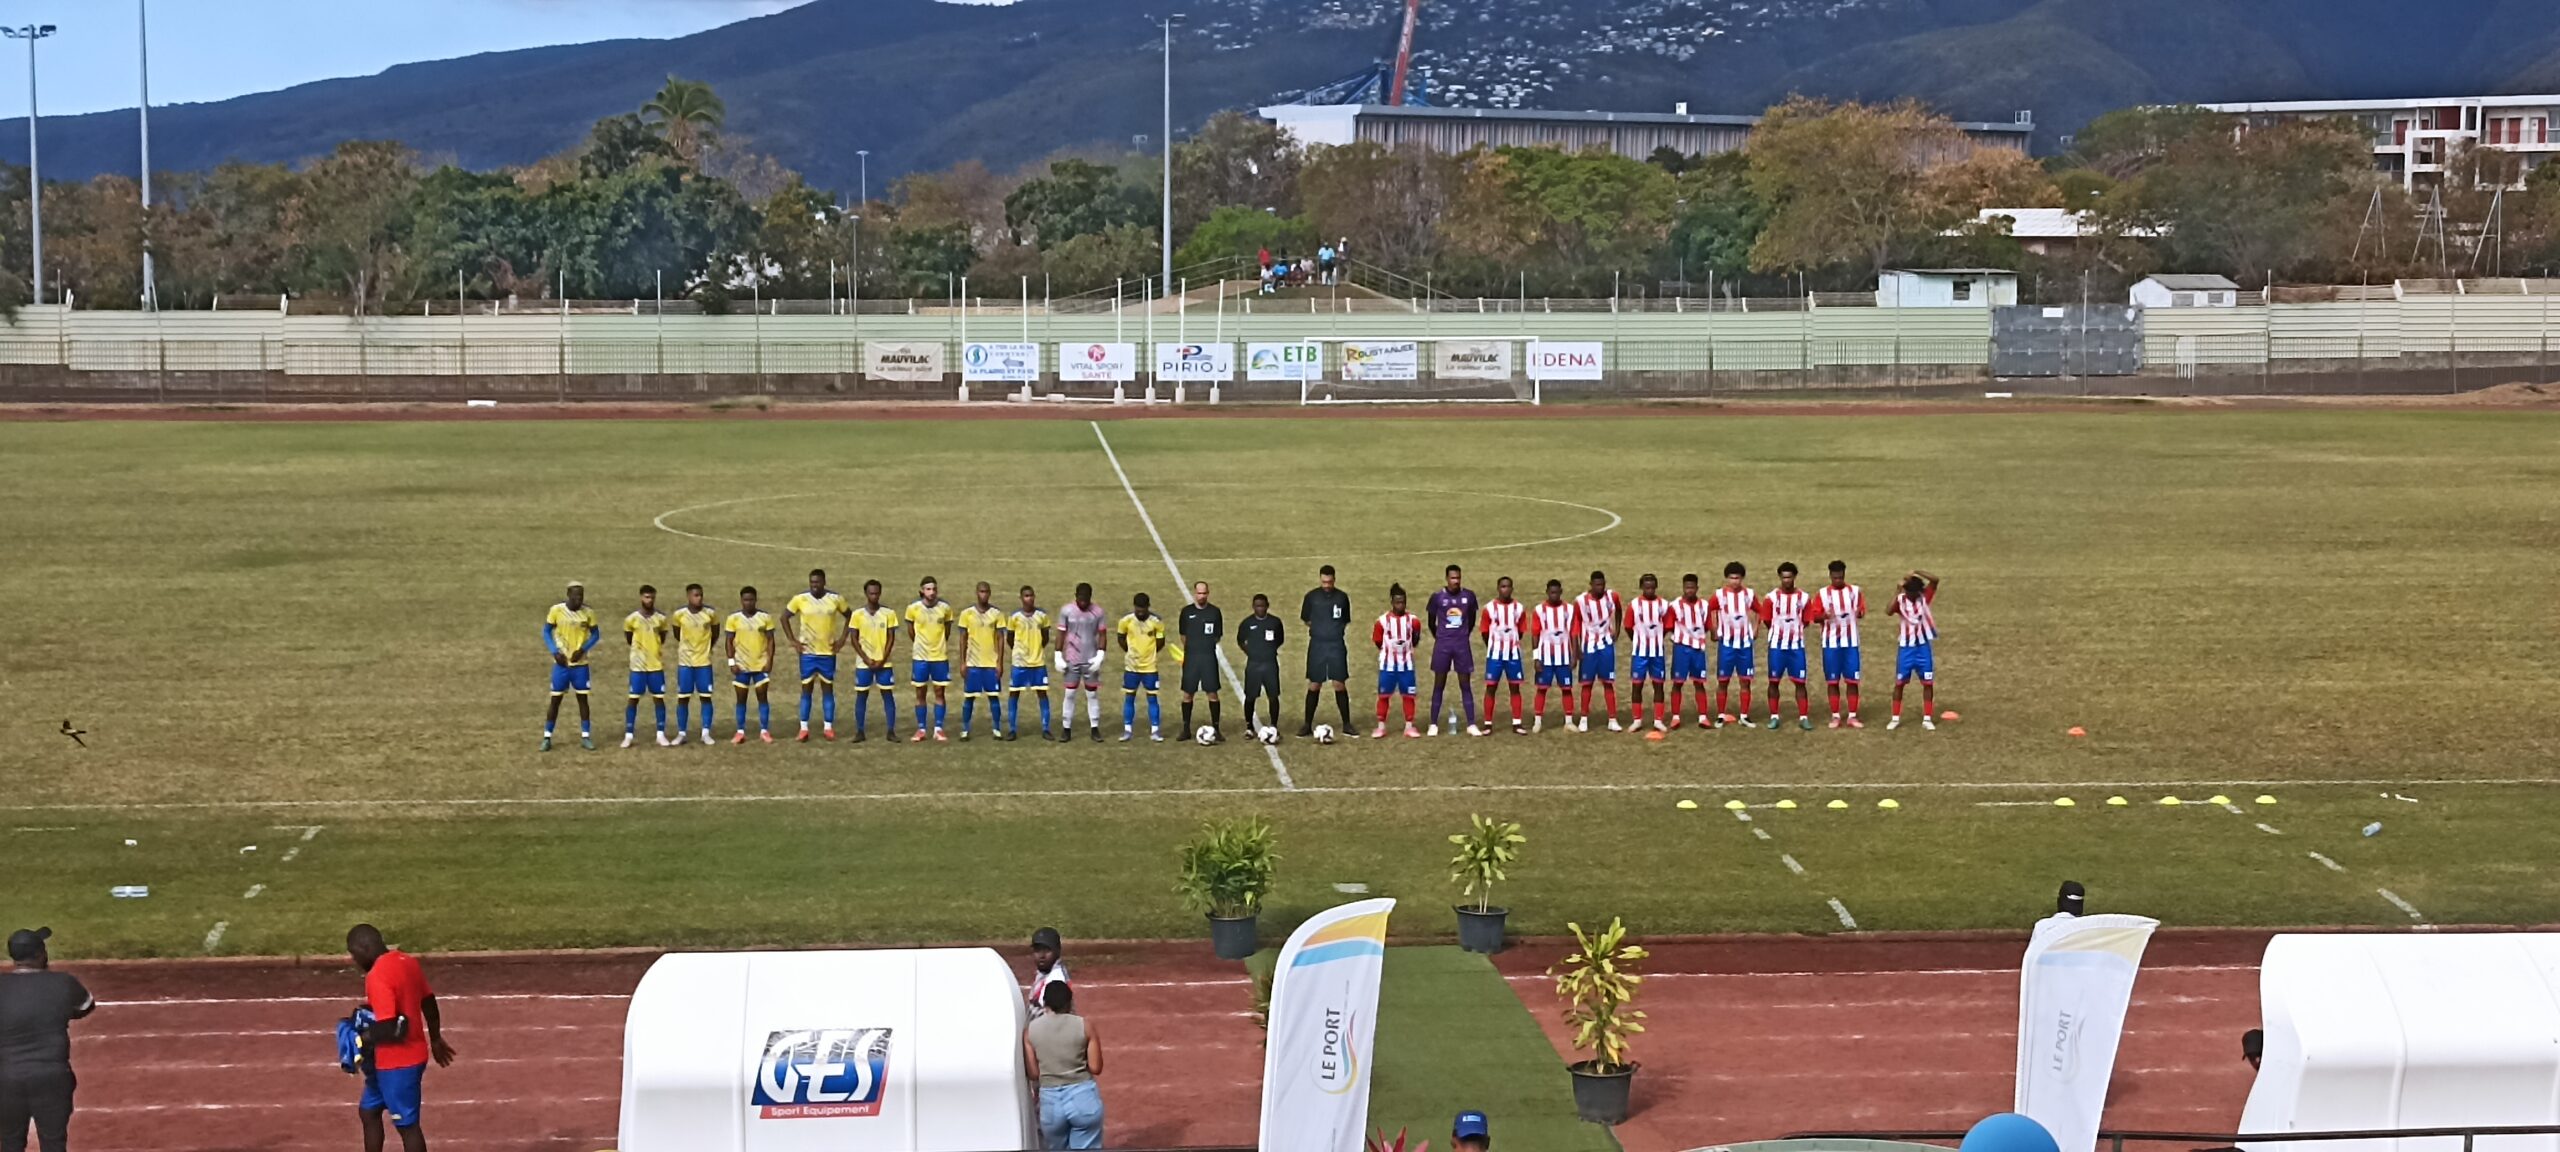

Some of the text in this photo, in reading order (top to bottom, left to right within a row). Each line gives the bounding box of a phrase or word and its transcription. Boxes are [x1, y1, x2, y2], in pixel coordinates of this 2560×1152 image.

[881, 354, 930, 363] MAUVILAC
[1283, 345, 1317, 362] ETB
[1451, 353, 1499, 362] MAUVILAC
[1532, 352, 1596, 366] EDENA
[1070, 362, 1093, 370] VITAL
[1321, 1008, 1341, 1080] LE PORT
[2052, 1009, 2072, 1072] LE PORT
[760, 1029, 885, 1103] GES
[770, 1105, 870, 1117] Sport Equipement
